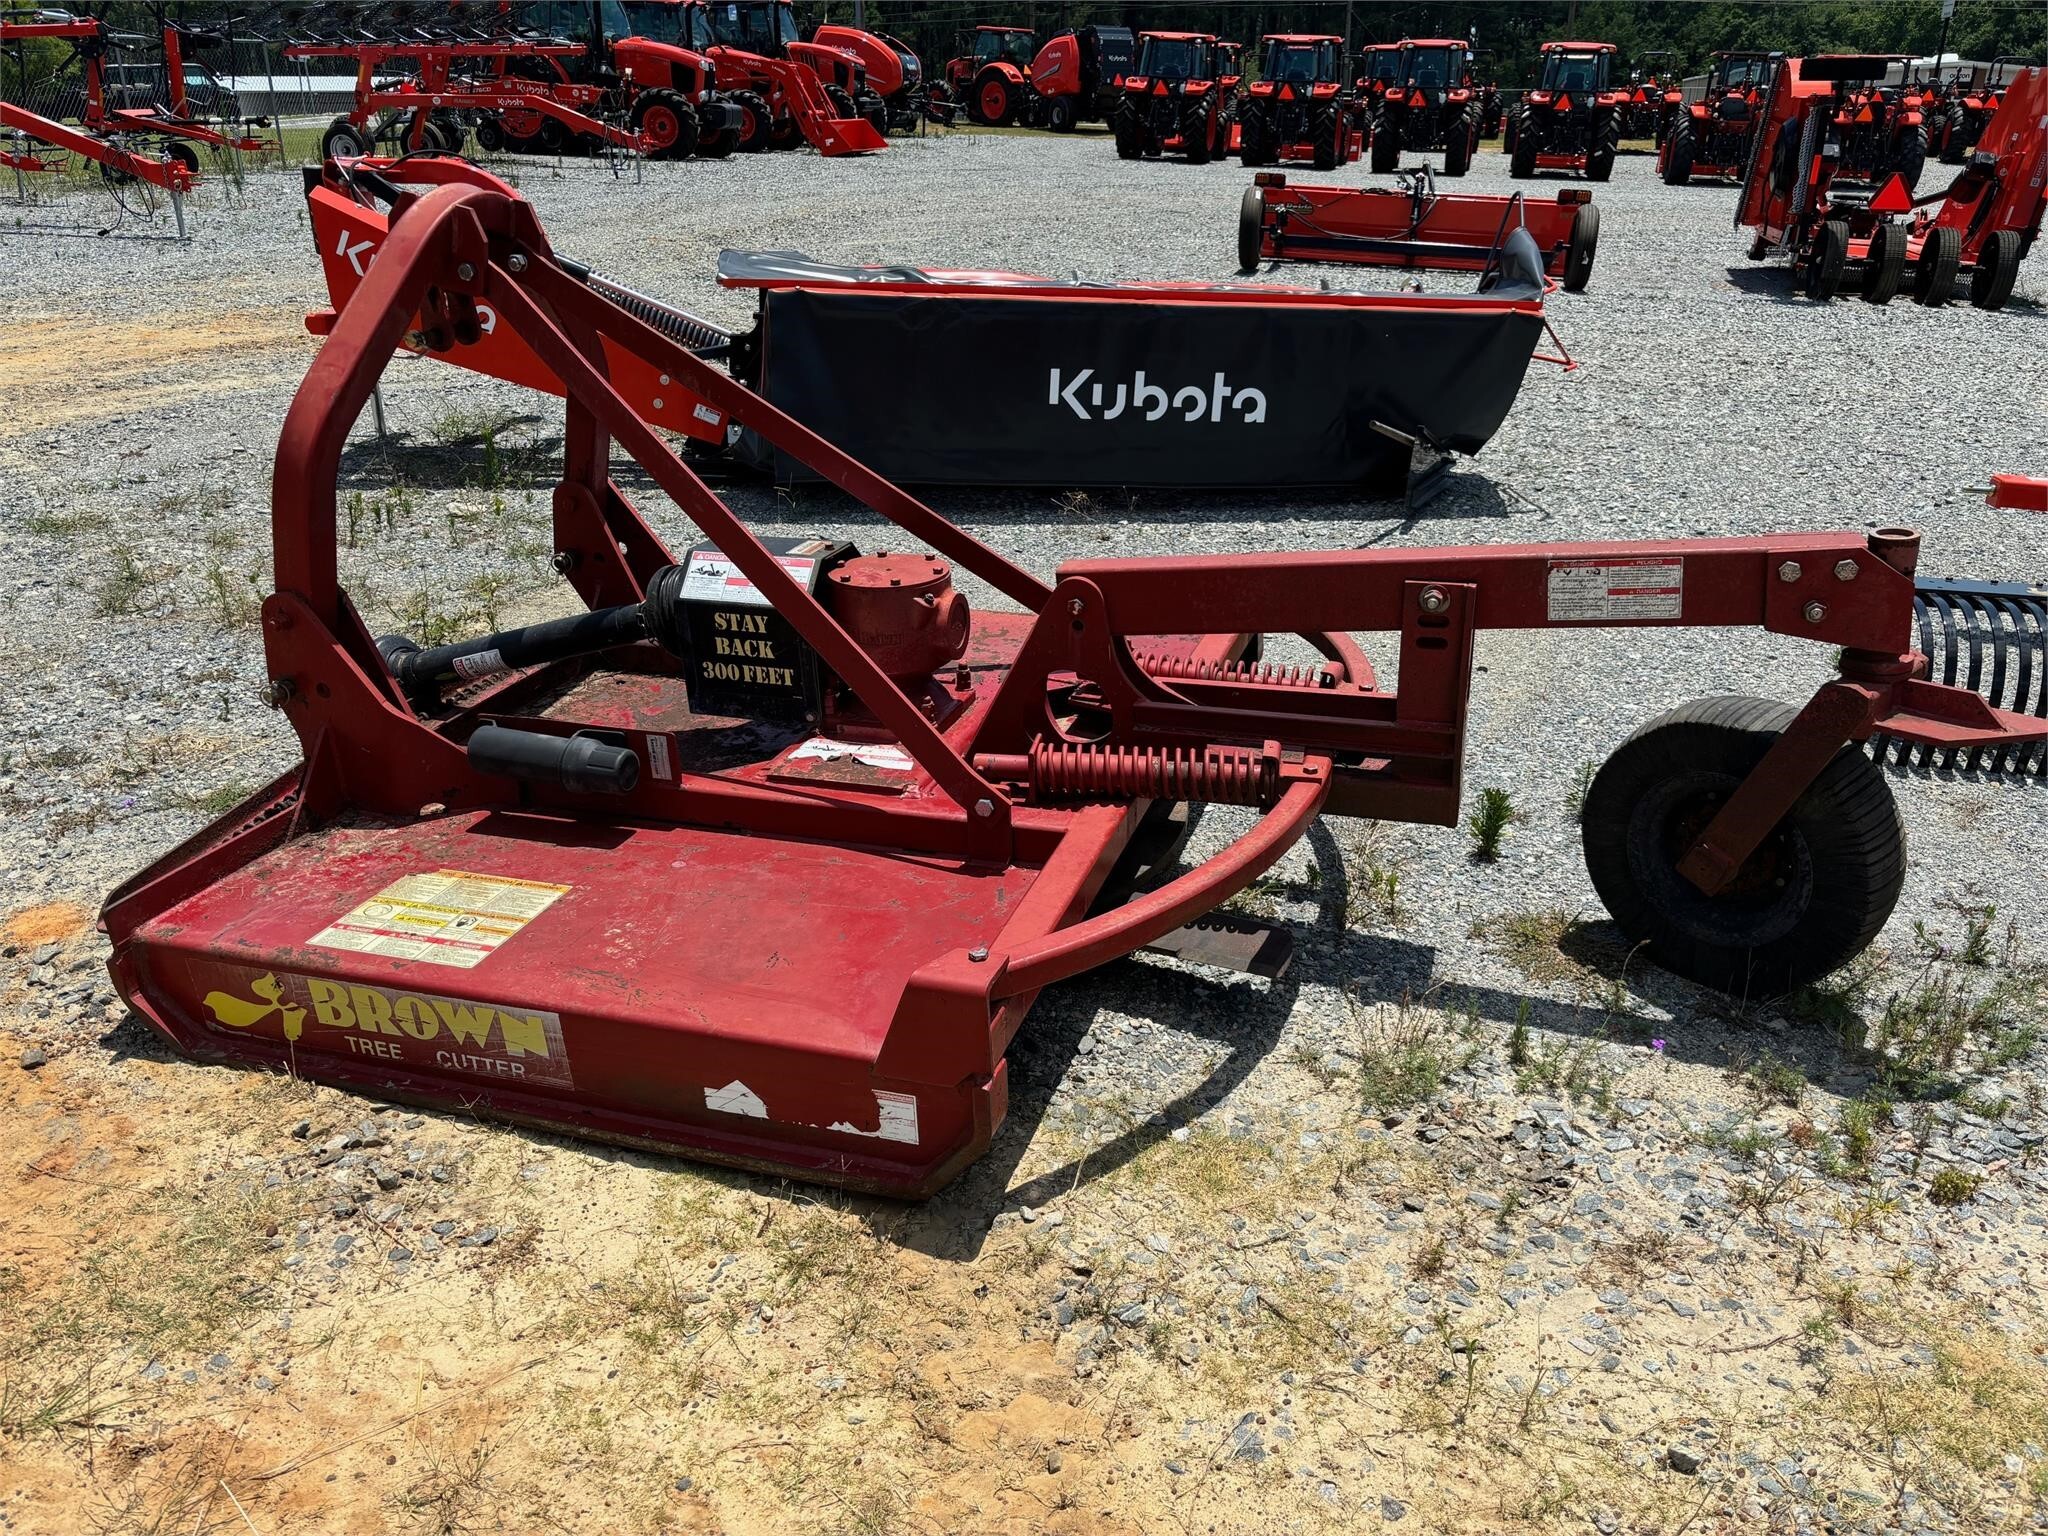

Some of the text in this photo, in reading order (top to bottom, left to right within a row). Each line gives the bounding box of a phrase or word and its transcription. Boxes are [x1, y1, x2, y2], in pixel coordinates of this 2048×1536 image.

[516, 83, 550, 96] Kubota
[497, 98, 525, 107] Kubota
[1049, 368, 1267, 423] Kubota
[714, 612, 768, 634] STAY
[714, 636, 776, 659] BACK
[702, 661, 794, 686] 300 FEET
[307, 978, 550, 1058] BROWN
[344, 1035, 526, 1079] TREE CUTTER
